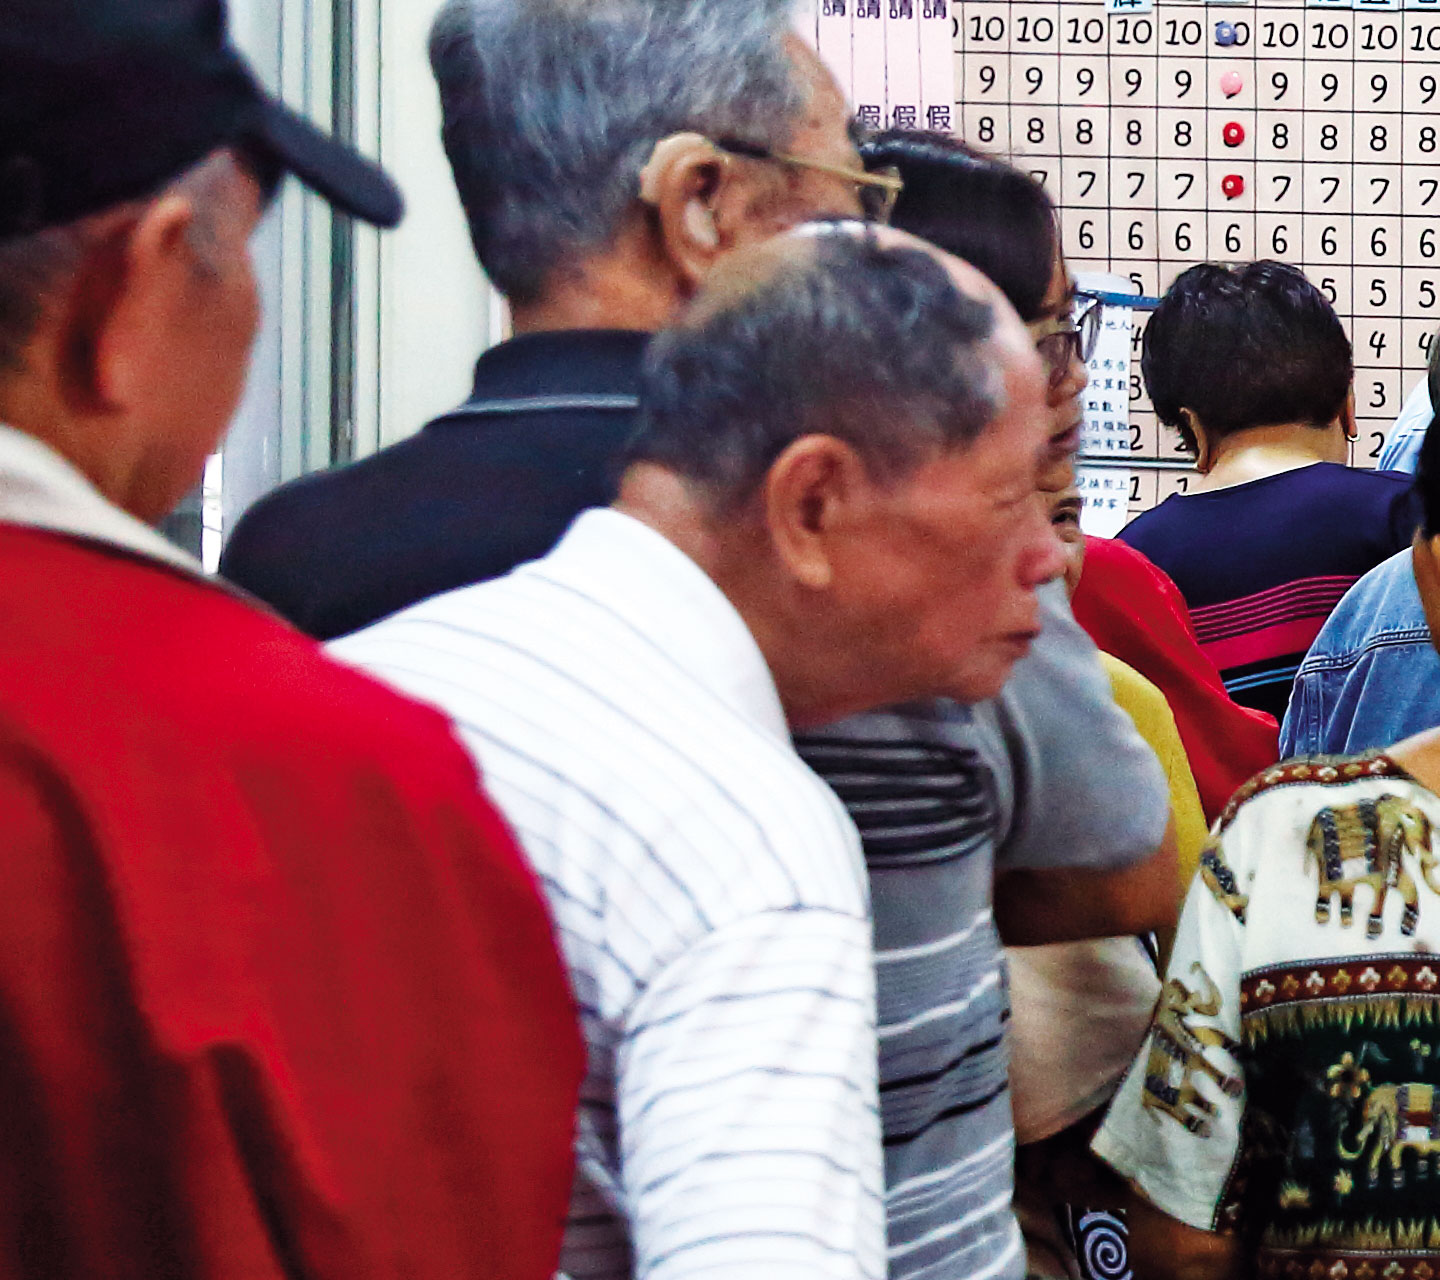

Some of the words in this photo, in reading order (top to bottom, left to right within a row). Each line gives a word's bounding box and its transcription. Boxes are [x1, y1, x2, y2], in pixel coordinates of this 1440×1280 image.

[969, 15, 1005, 42] 10
[1016, 16, 1054, 43] 10
[1067, 17, 1104, 44] 10
[1116, 18, 1152, 45] 10
[1165, 19, 1202, 46] 10
[1262, 21, 1299, 48] 10
[1312, 22, 1348, 49] 10
[1361, 23, 1398, 50] 10
[979, 65, 995, 94] 9
[1025, 66, 1043, 95] 9
[1076, 68, 1094, 96] 9
[1125, 68, 1142, 98] 9
[1175, 69, 1192, 99] 9
[1272, 72, 1288, 101] 9
[1321, 73, 1338, 102] 9
[1371, 74, 1387, 103] 9
[978, 116, 995, 143] 8
[1079, 220, 1094, 250] 6
[1128, 221, 1144, 250] 6
